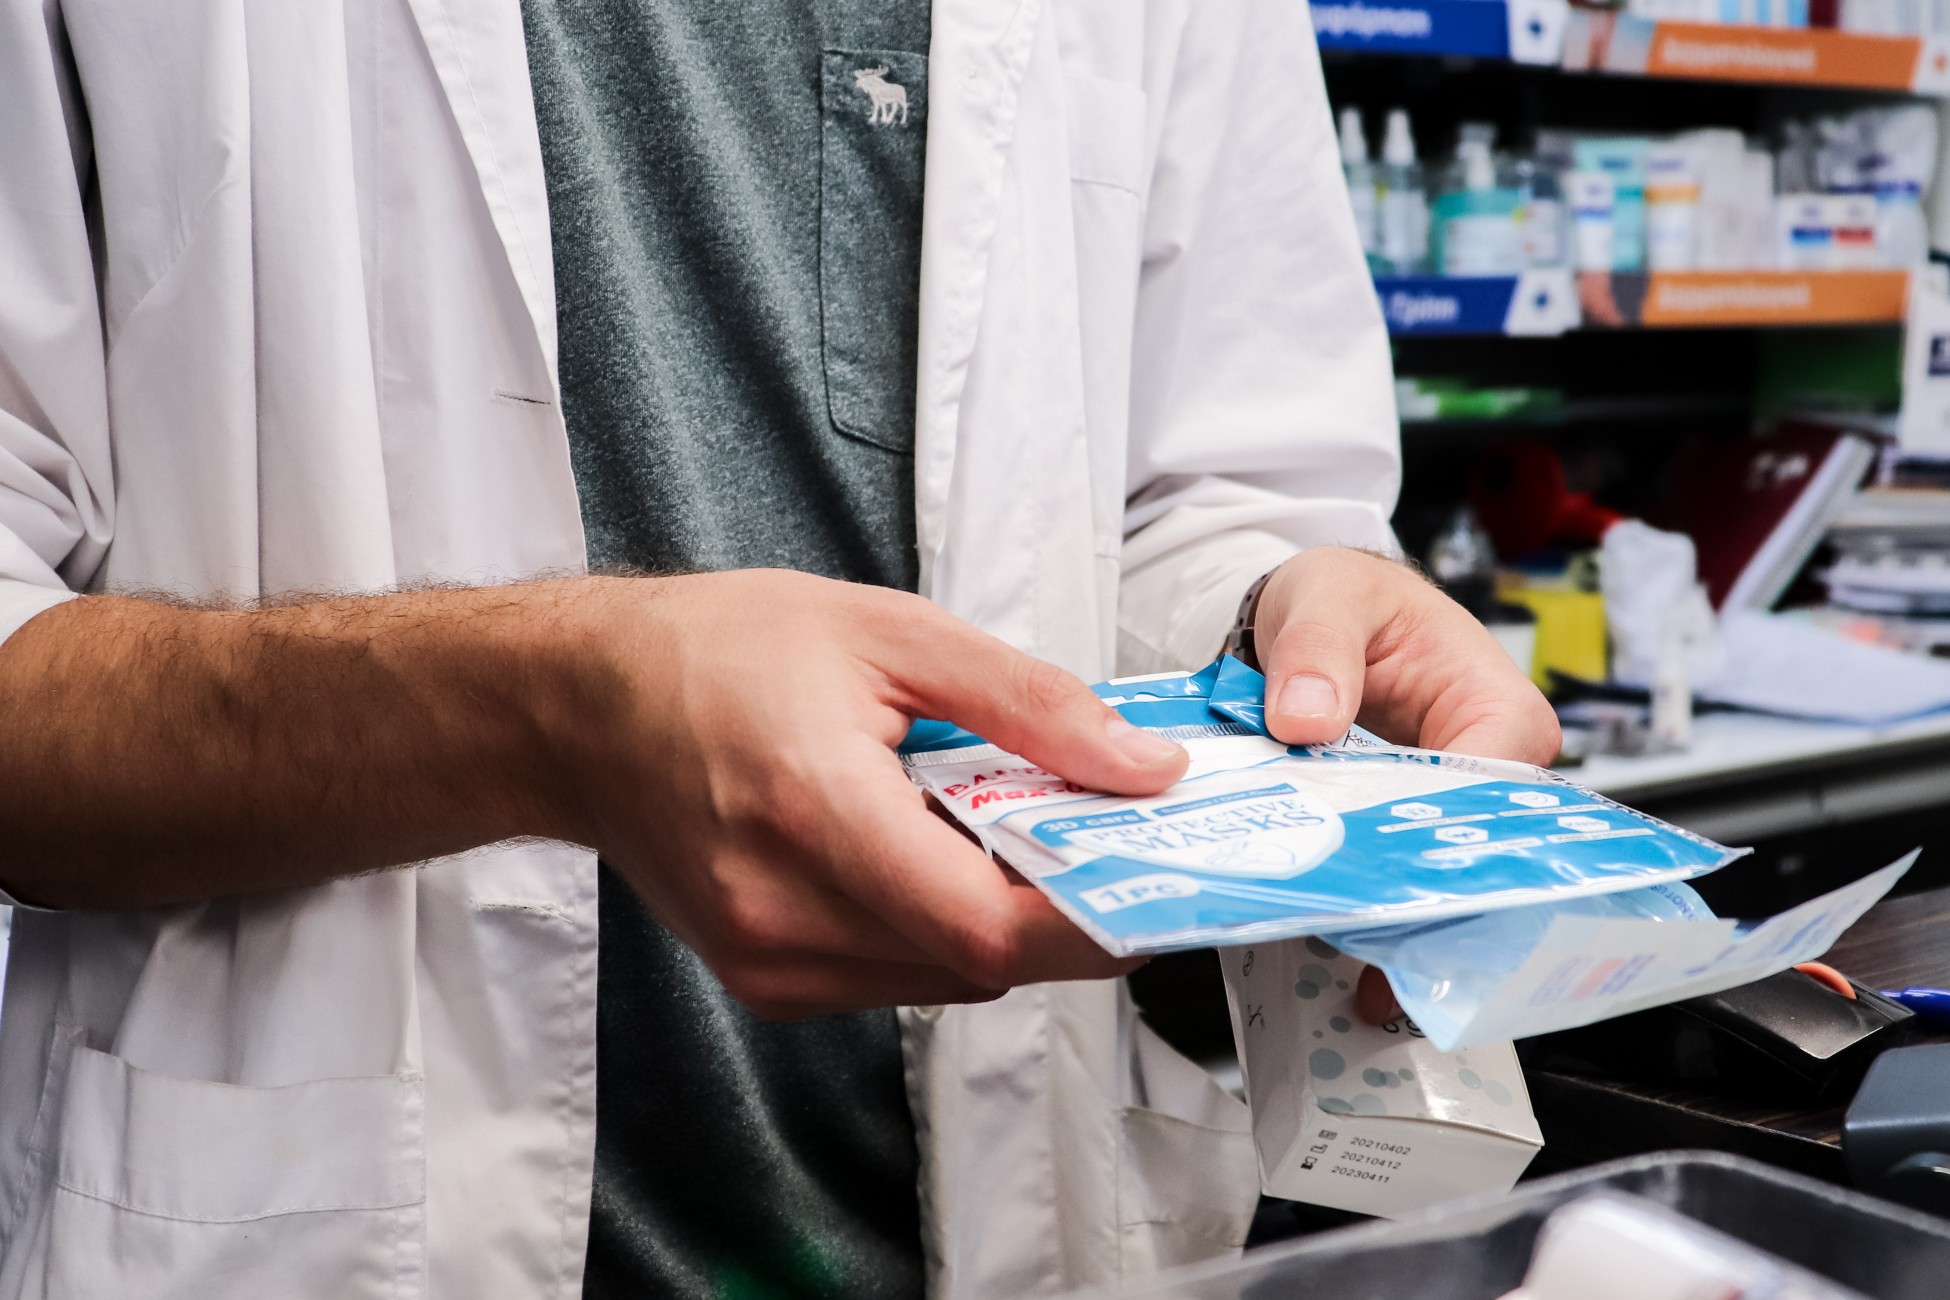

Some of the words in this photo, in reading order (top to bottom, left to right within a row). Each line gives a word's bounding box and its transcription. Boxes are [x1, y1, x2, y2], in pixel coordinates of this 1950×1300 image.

[1042, 820, 1080, 832] 3D
[1089, 813, 1140, 827] care
[1091, 799, 1305, 841] PROTECTIVE
[1119, 810, 1325, 853] MASKS
[1350, 1137, 1411, 1155] 20210402
[1341, 1151, 1402, 1170] 20210412
[1331, 1165, 1390, 1183] 20230411
